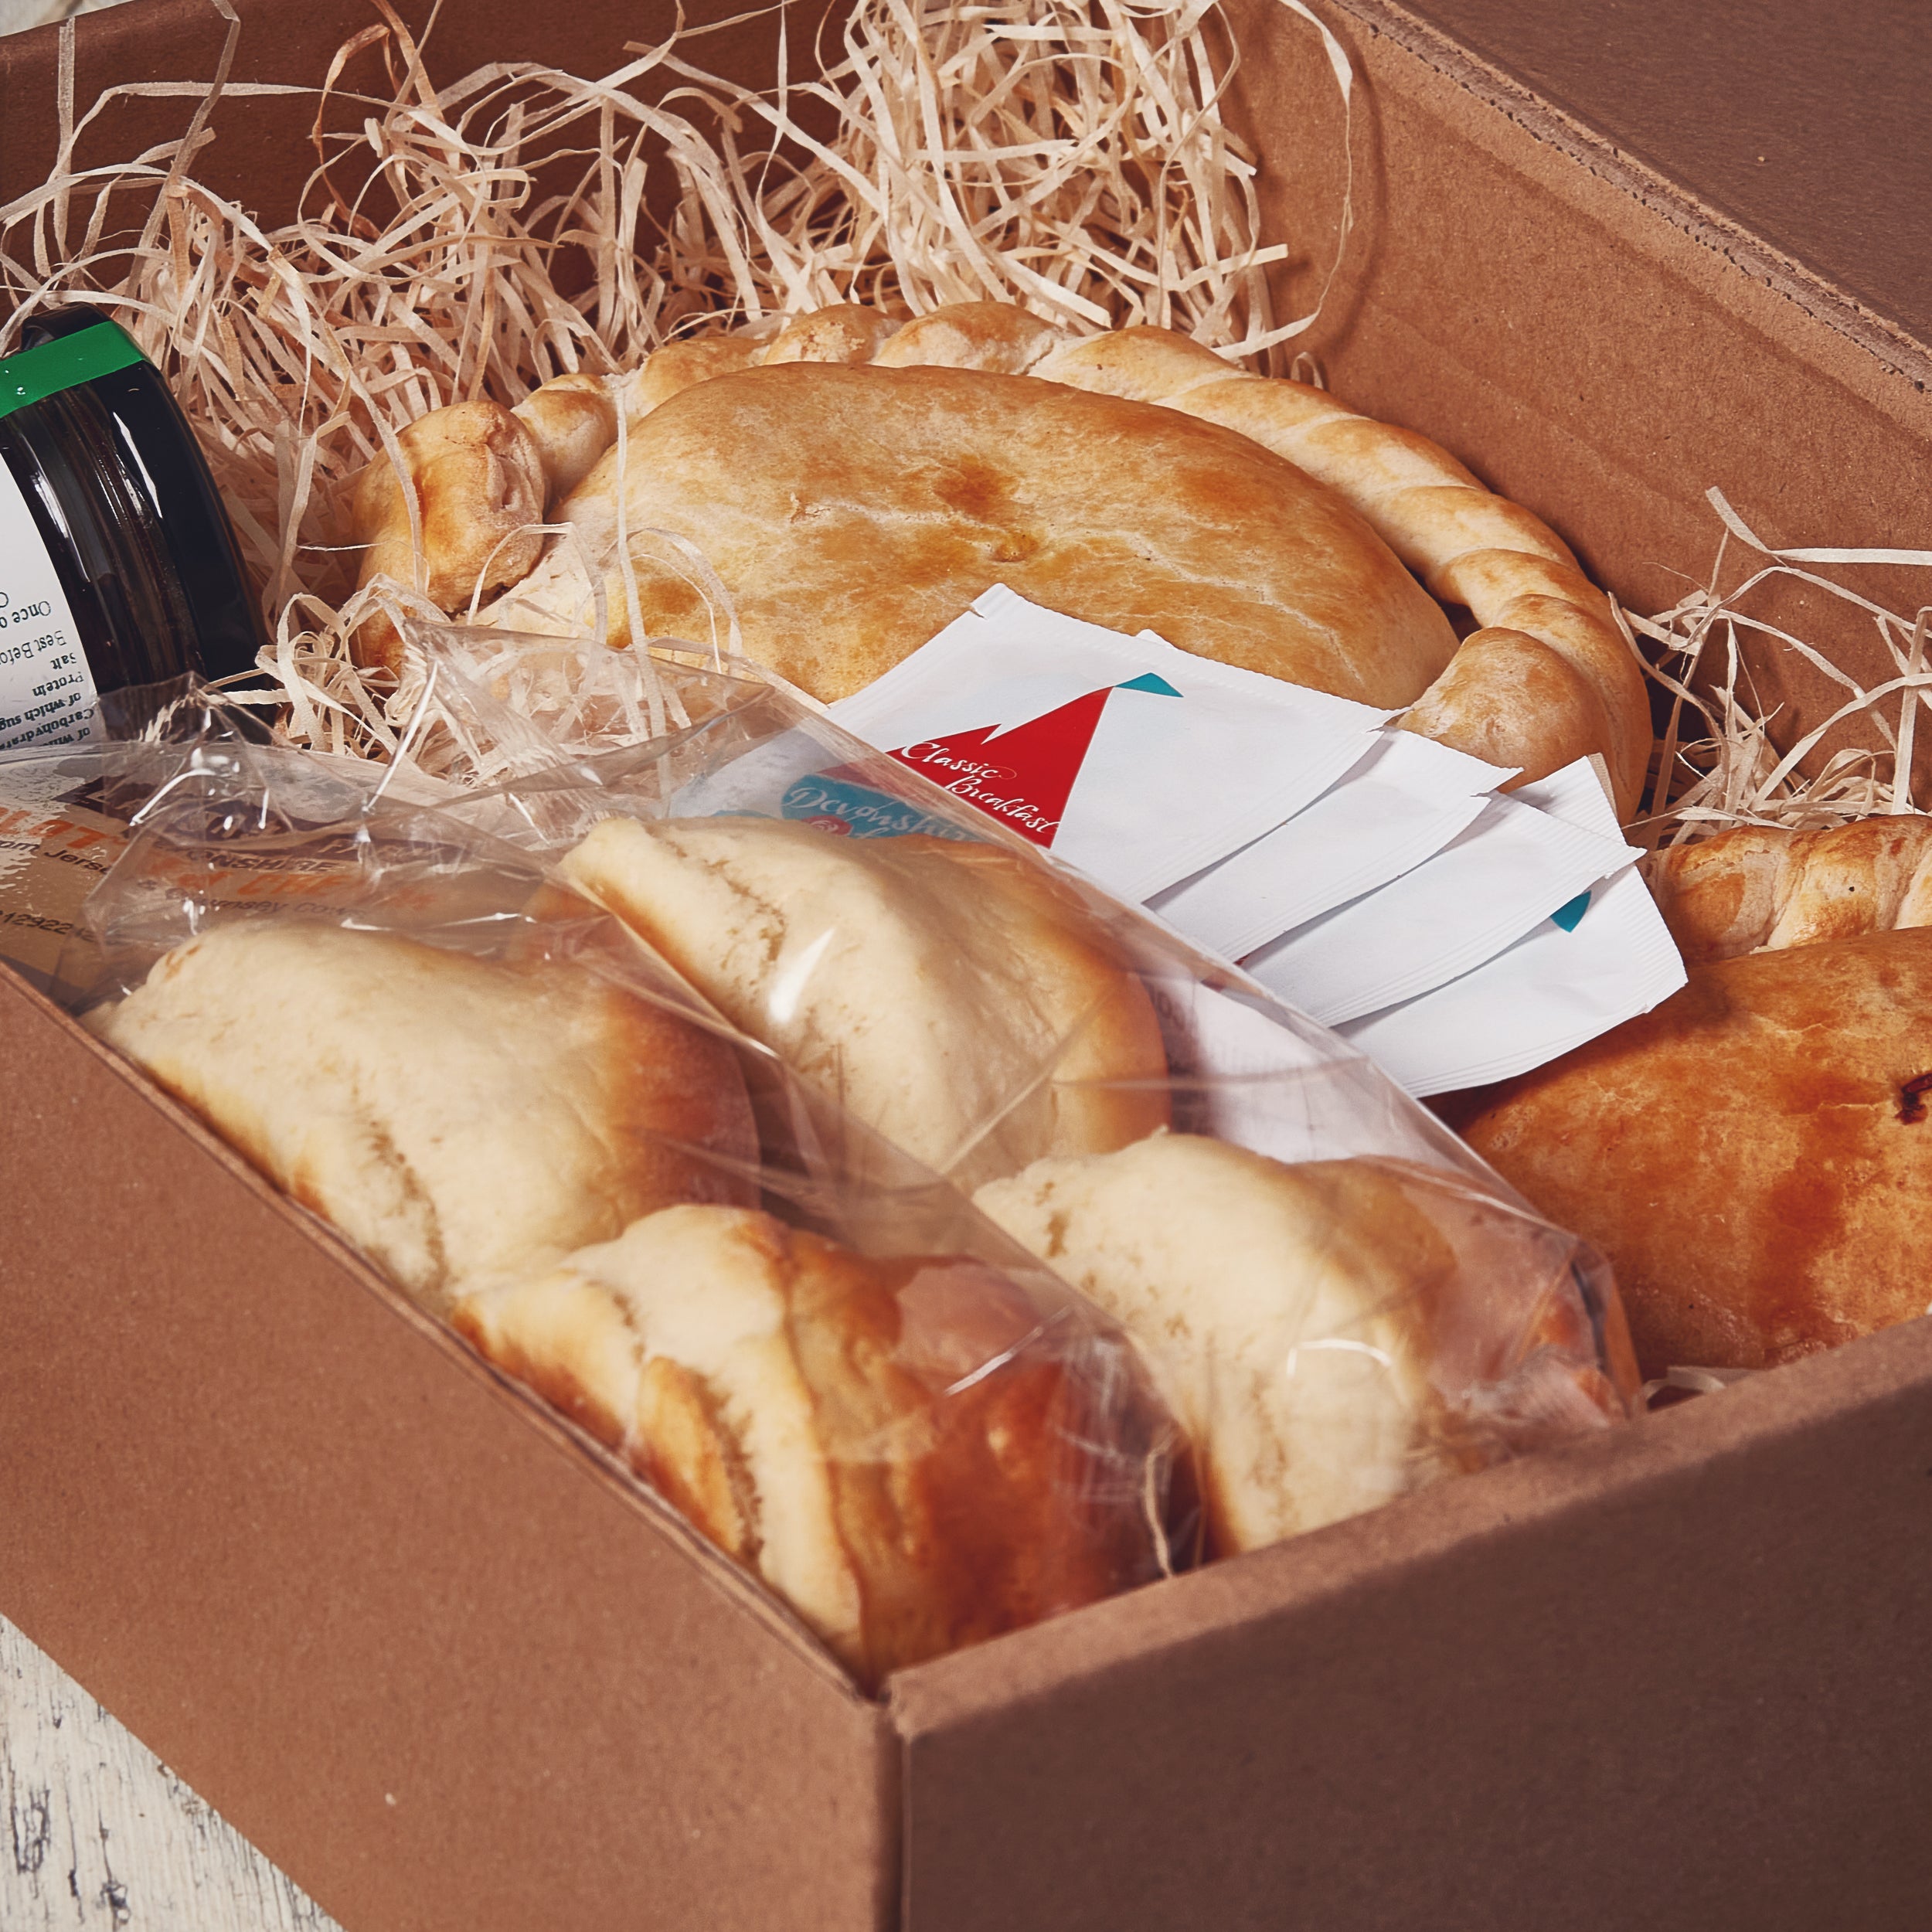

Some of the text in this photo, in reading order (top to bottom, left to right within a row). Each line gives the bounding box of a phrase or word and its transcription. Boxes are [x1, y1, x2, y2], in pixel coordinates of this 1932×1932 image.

[12, 600, 52, 624] Once
[0, 630, 67, 666] Best Befo
[50, 651, 78, 670] Salt
[32, 671, 85, 696] Protein
[0, 692, 82, 732] of which sug
[77, 727, 90, 741] of
[901, 742, 1016, 779] Classic
[783, 787, 972, 844] Devonshir
[944, 775, 1060, 835] Breakfast
[44, 849, 114, 876] Jerse
